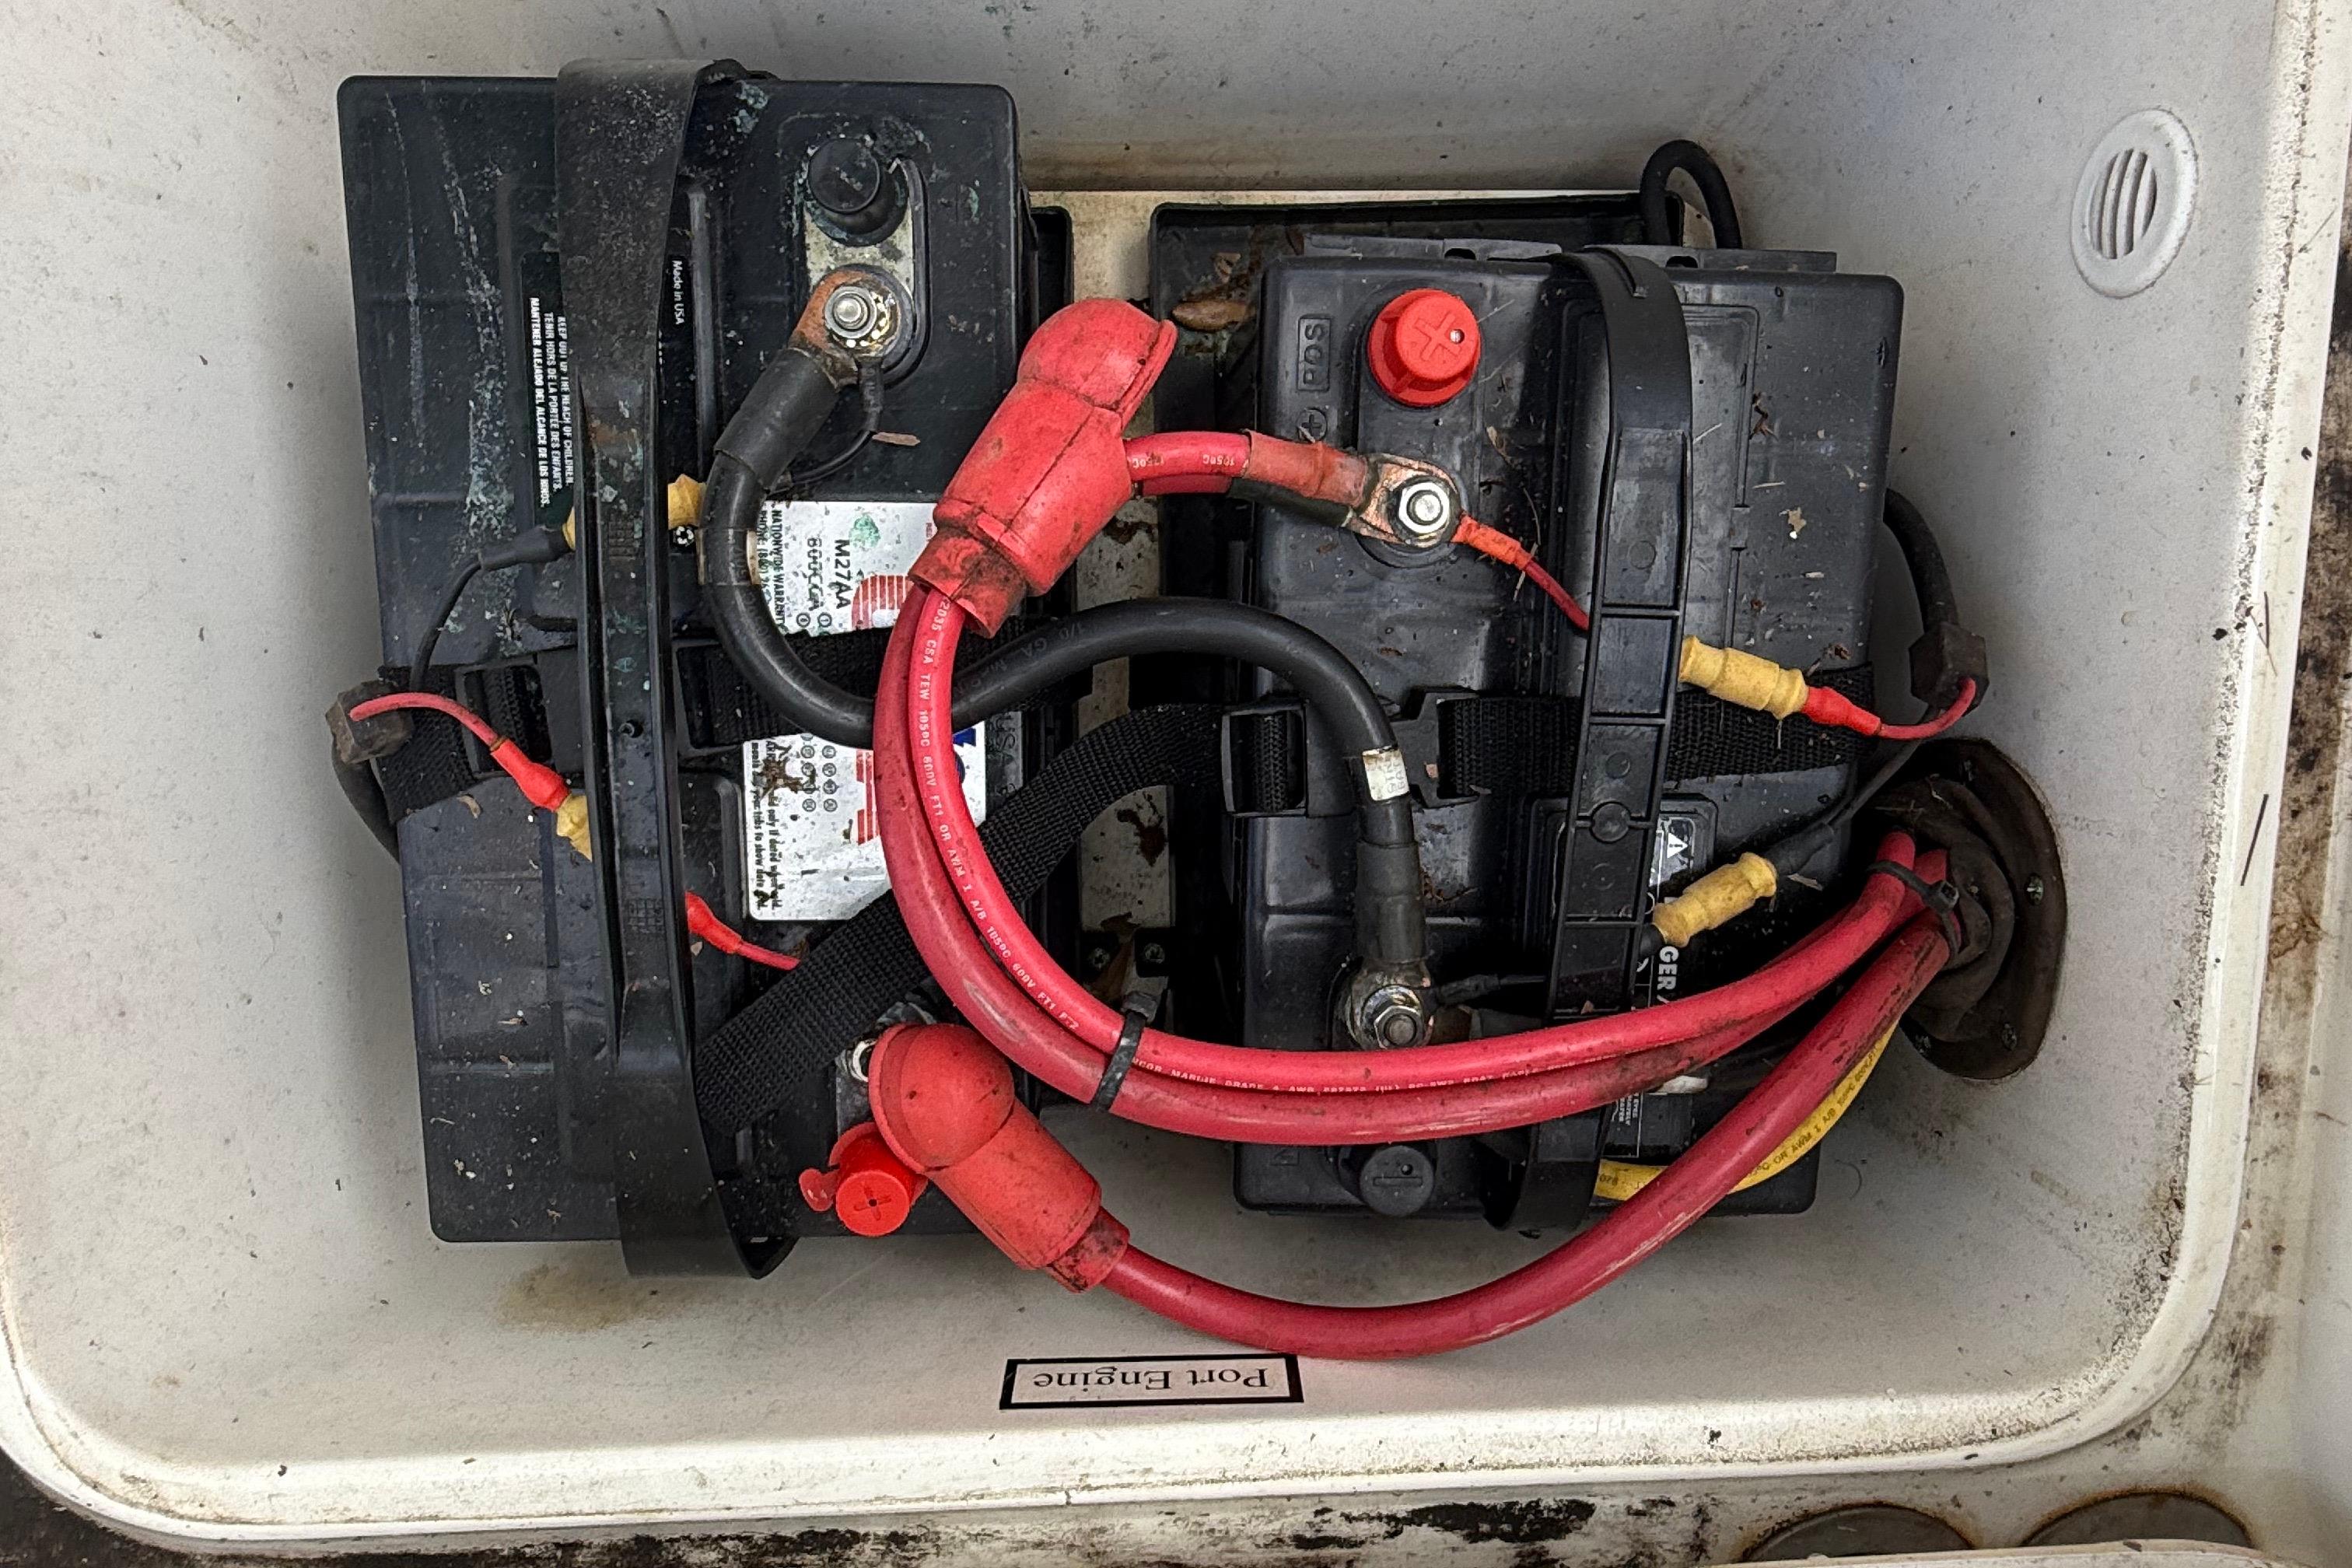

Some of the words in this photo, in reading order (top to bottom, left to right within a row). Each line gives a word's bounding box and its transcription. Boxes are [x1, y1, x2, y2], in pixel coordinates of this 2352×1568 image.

[672, 261, 683, 289] Made
[674, 292, 684, 301] in
[530, 298, 542, 345] MANTENER
[674, 303, 684, 324] USA
[547, 341, 557, 366] HORS
[1303, 324, 1325, 385] POS
[533, 348, 544, 387] ALEJADO
[548, 368, 557, 380] DE
[535, 388, 545, 404] DEL
[548, 382, 558, 394] LA
[562, 394, 572, 423] REACH
[535, 406, 548, 445] ALCANCE
[563, 426, 572, 438] OF
[551, 431, 560, 449] DES
[537, 447, 548, 458] DE
[539, 460, 549, 477] LOS
[771, 510, 784, 572] NATIONWIDE
[835, 540, 852, 610] M27AA
[774, 573, 788, 632] WARRANTY
[923, 639, 937, 663] CSA
[920, 674, 932, 700] TEW
[922, 756, 937, 786] 600V
[930, 795, 943, 816] FT1
[940, 824, 952, 841] OR
[948, 849, 966, 877] AWM
[971, 899, 987, 919] A/B
[1132, 1057, 1163, 1073] NCOR
[1033, 1367, 1171, 1392] Engine
[1187, 1369, 1269, 1388] Port
